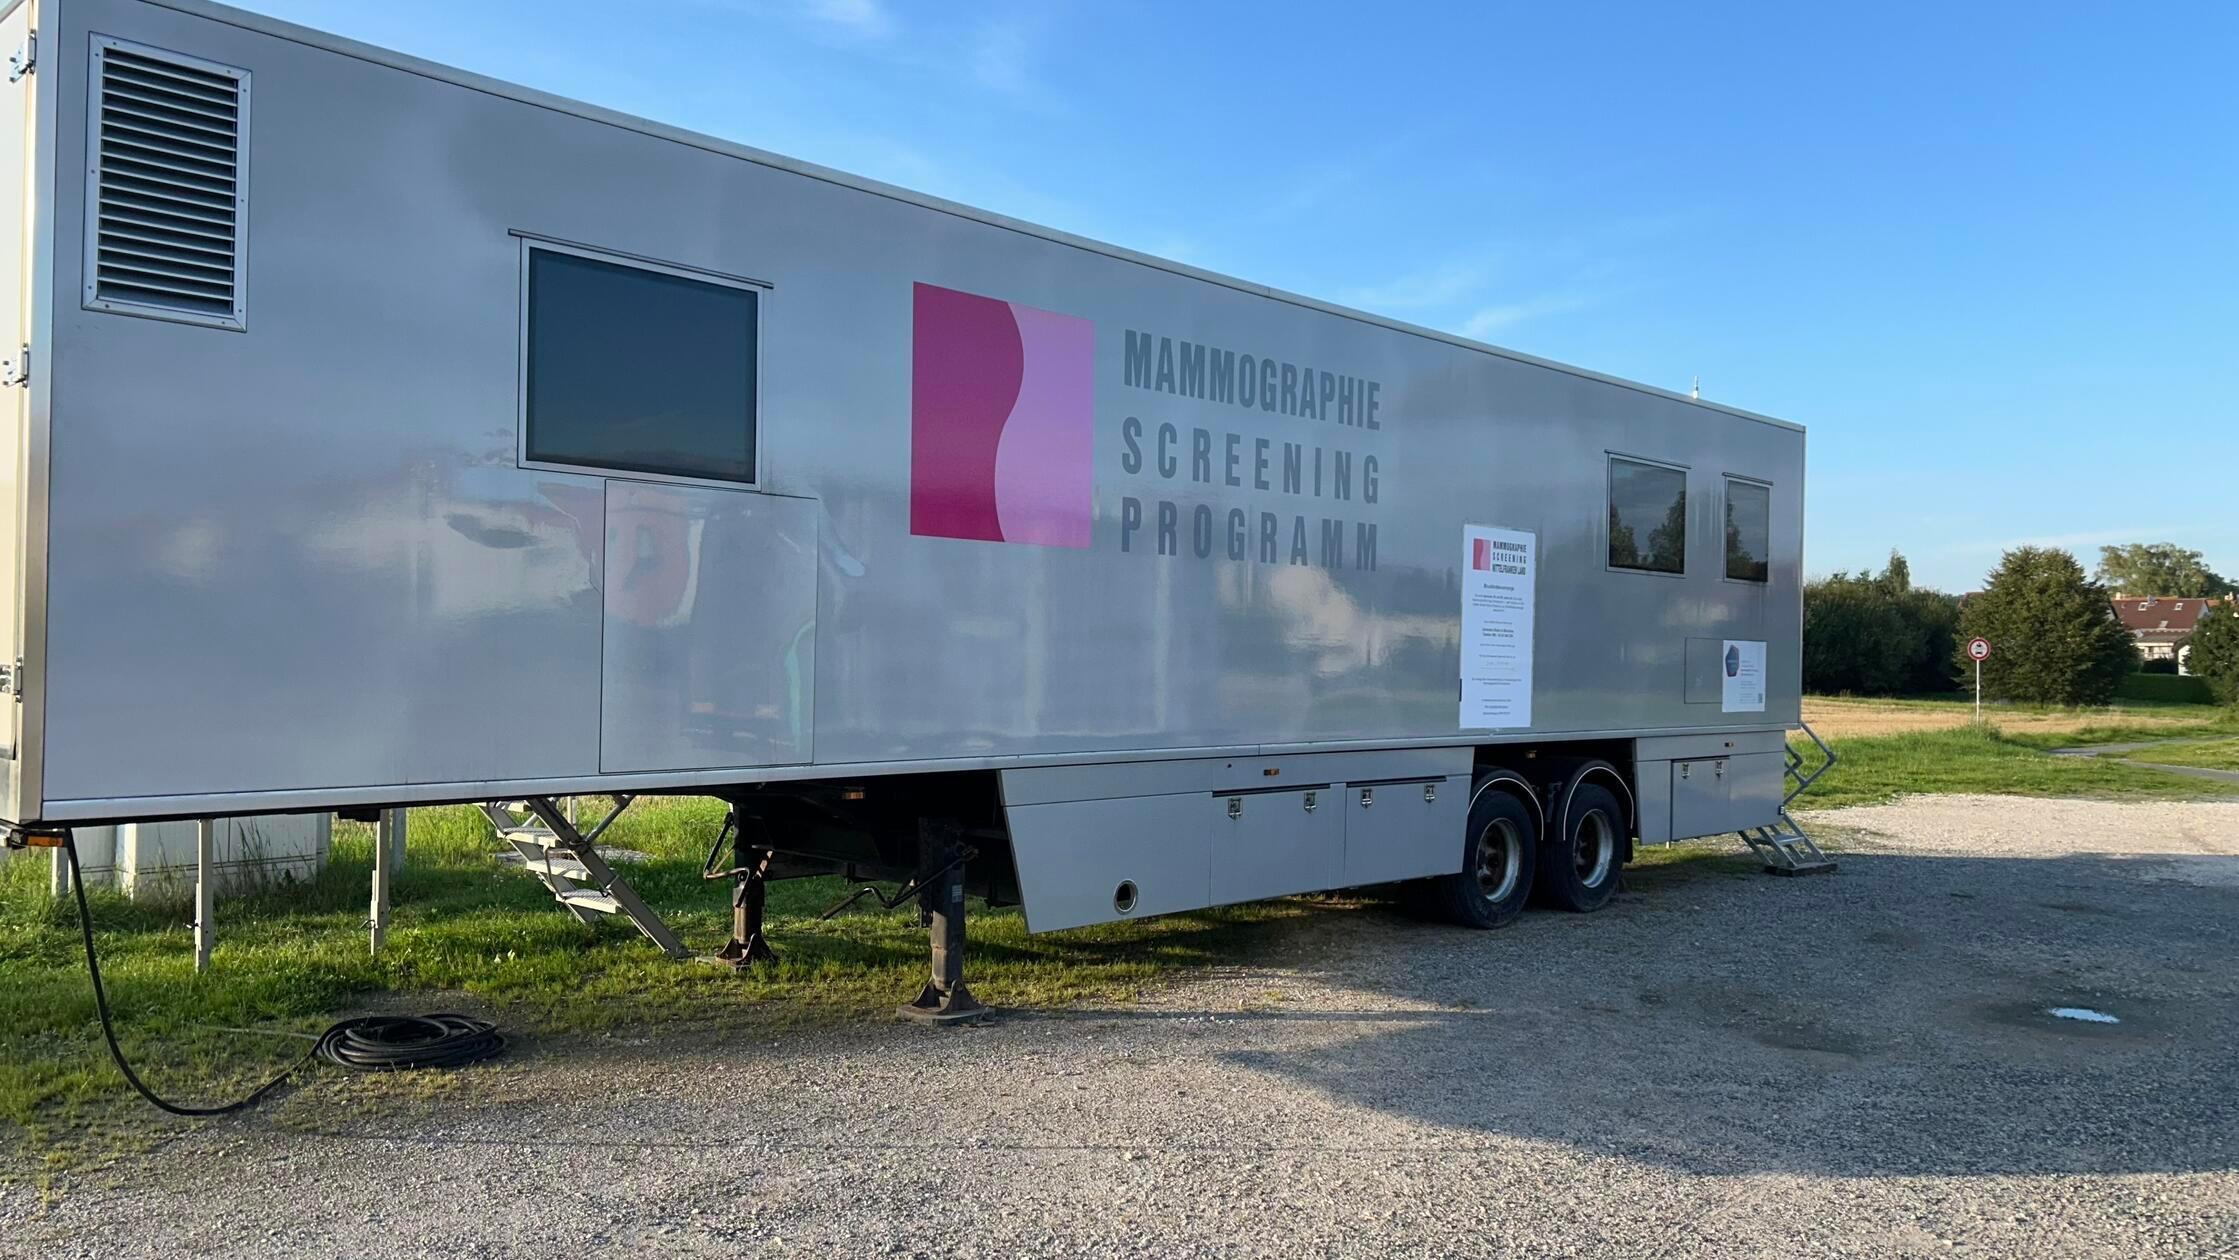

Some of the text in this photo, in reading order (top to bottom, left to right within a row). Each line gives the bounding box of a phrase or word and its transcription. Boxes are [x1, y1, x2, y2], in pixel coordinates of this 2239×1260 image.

[1124, 329, 1381, 431] MAMMOGRAPHIE
[1121, 416, 1379, 505] SCREENING
[1121, 496, 1377, 572] PROGRAMM
[1492, 551, 1527, 564] SCREENING
[1493, 541, 1527, 553] MAMMOGRAPHIE
